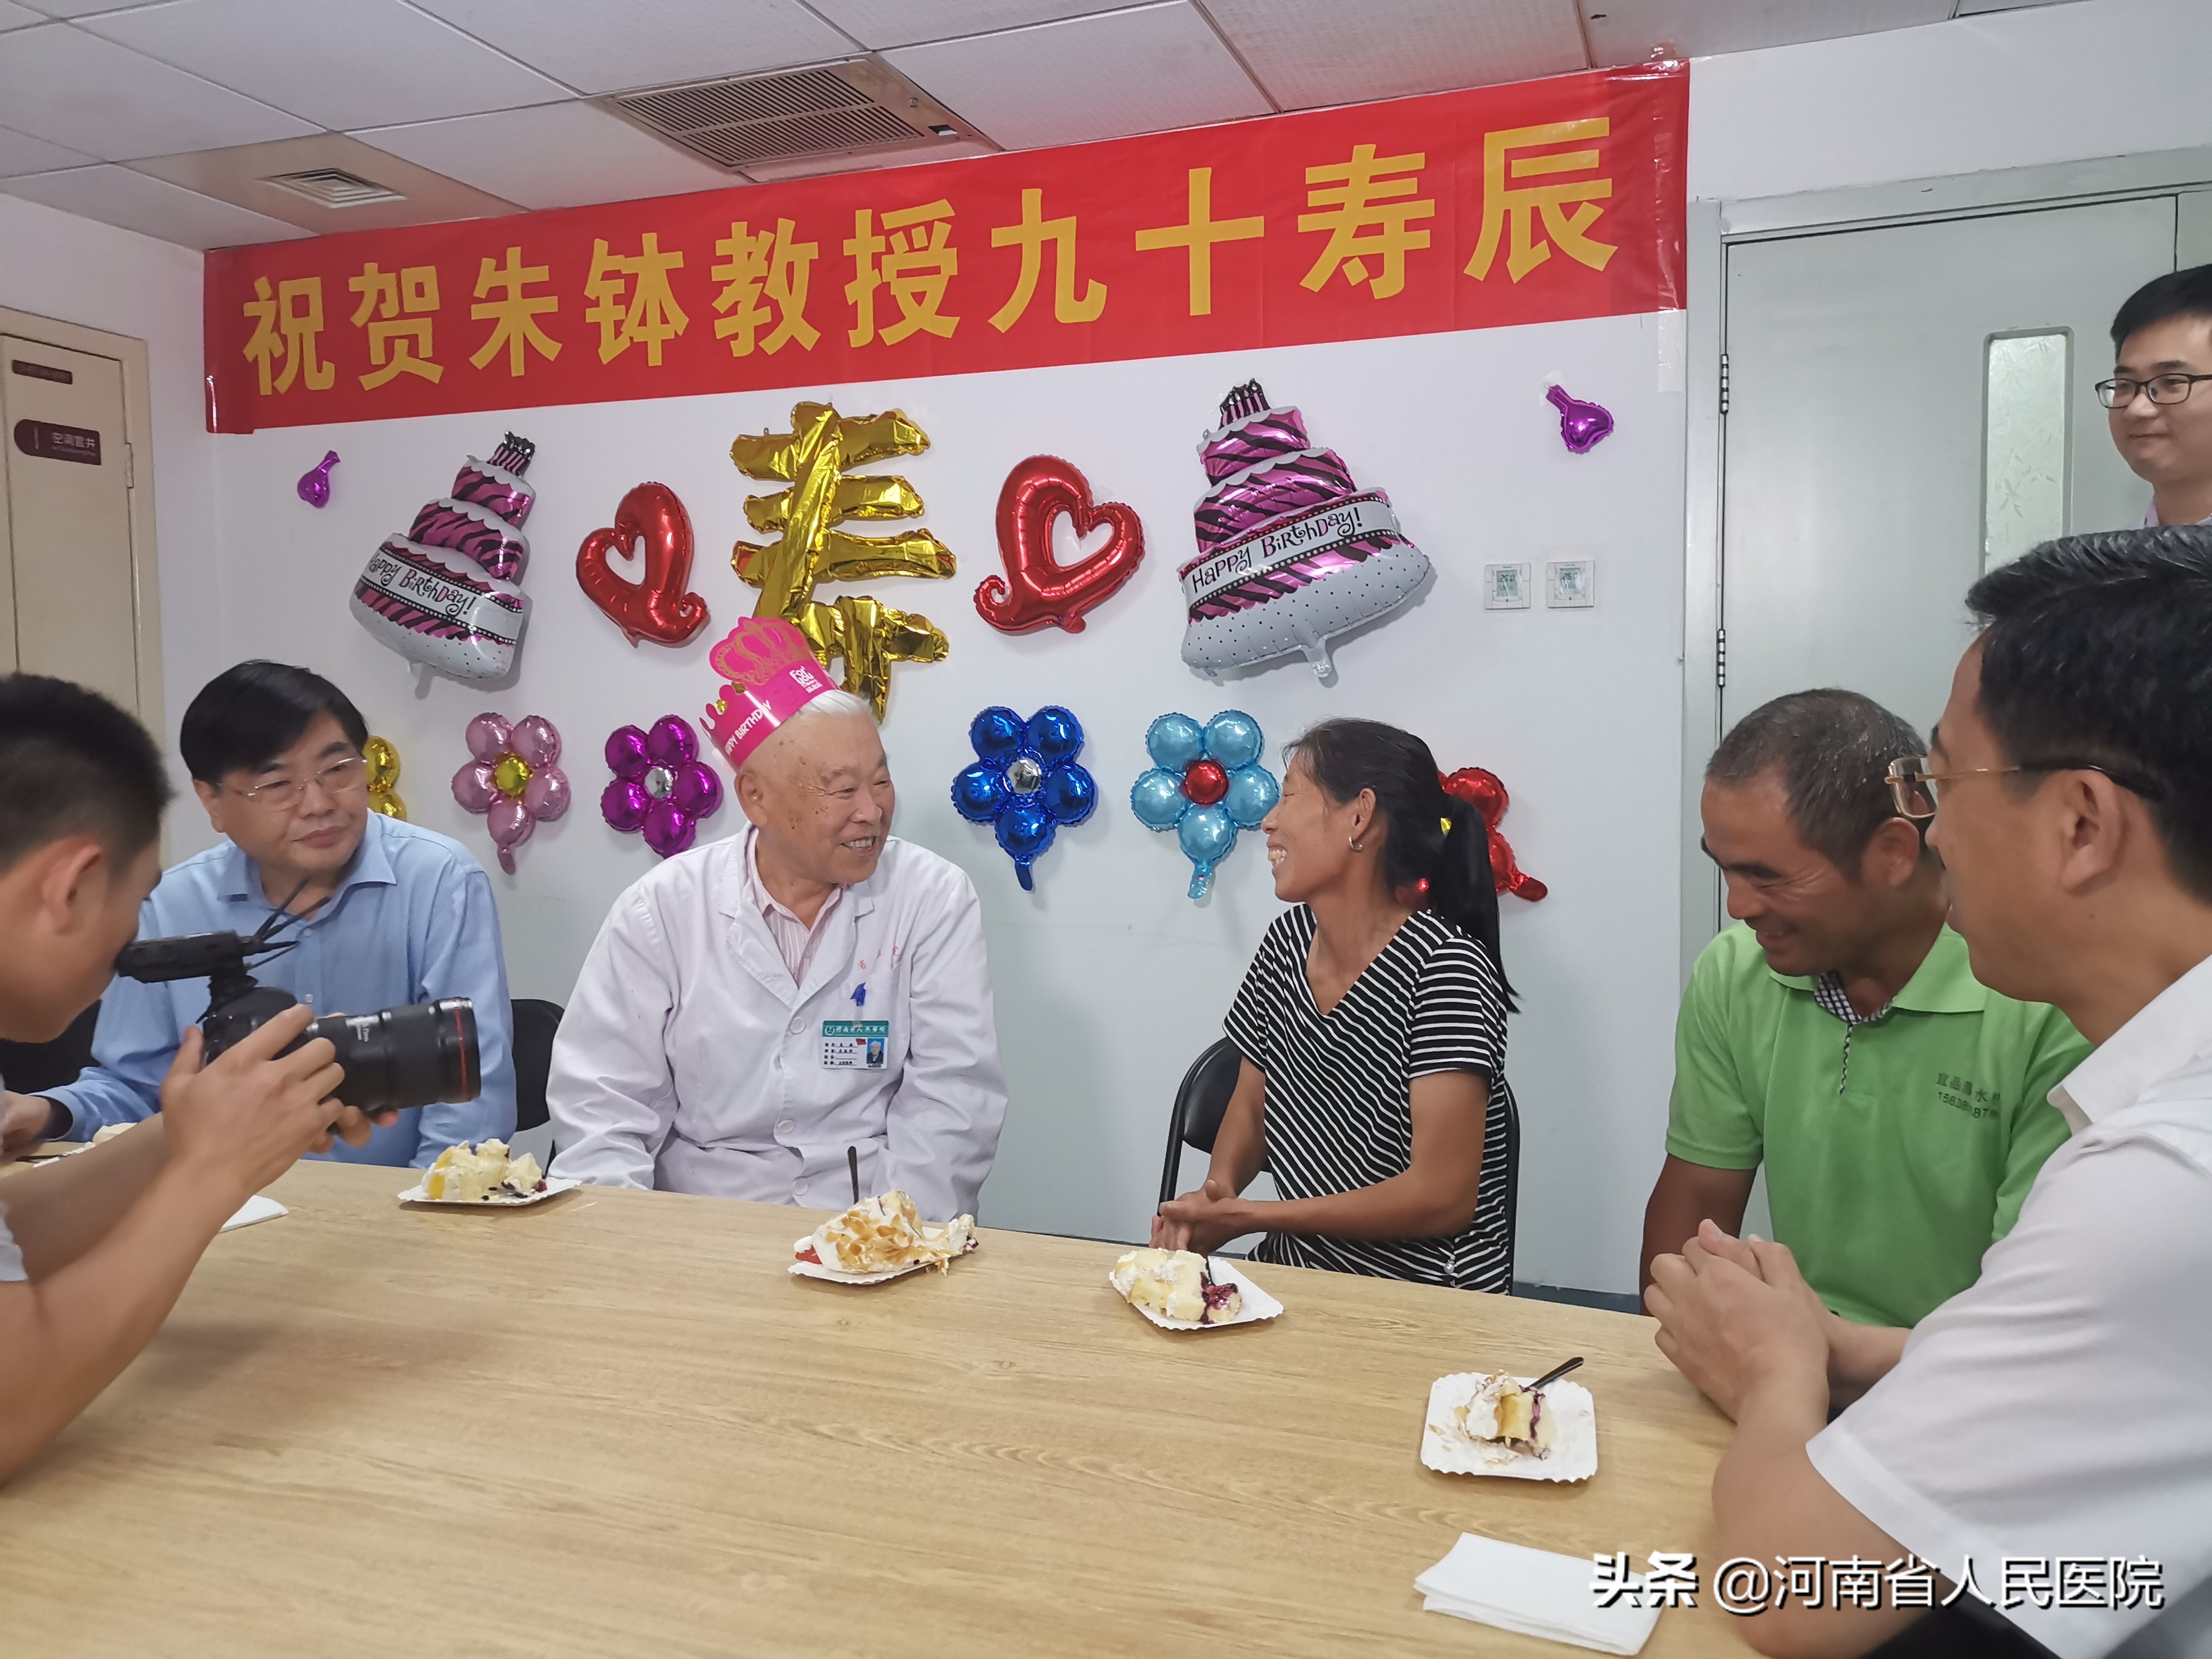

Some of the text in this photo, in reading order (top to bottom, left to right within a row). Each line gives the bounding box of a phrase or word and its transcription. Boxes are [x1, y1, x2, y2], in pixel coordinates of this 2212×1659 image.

[242, 117, 1618, 395] 祝贺朱钵教授九十寿辰
[1192, 546, 1250, 594] Happy
[734, 699, 772, 740] BIRTHDY
